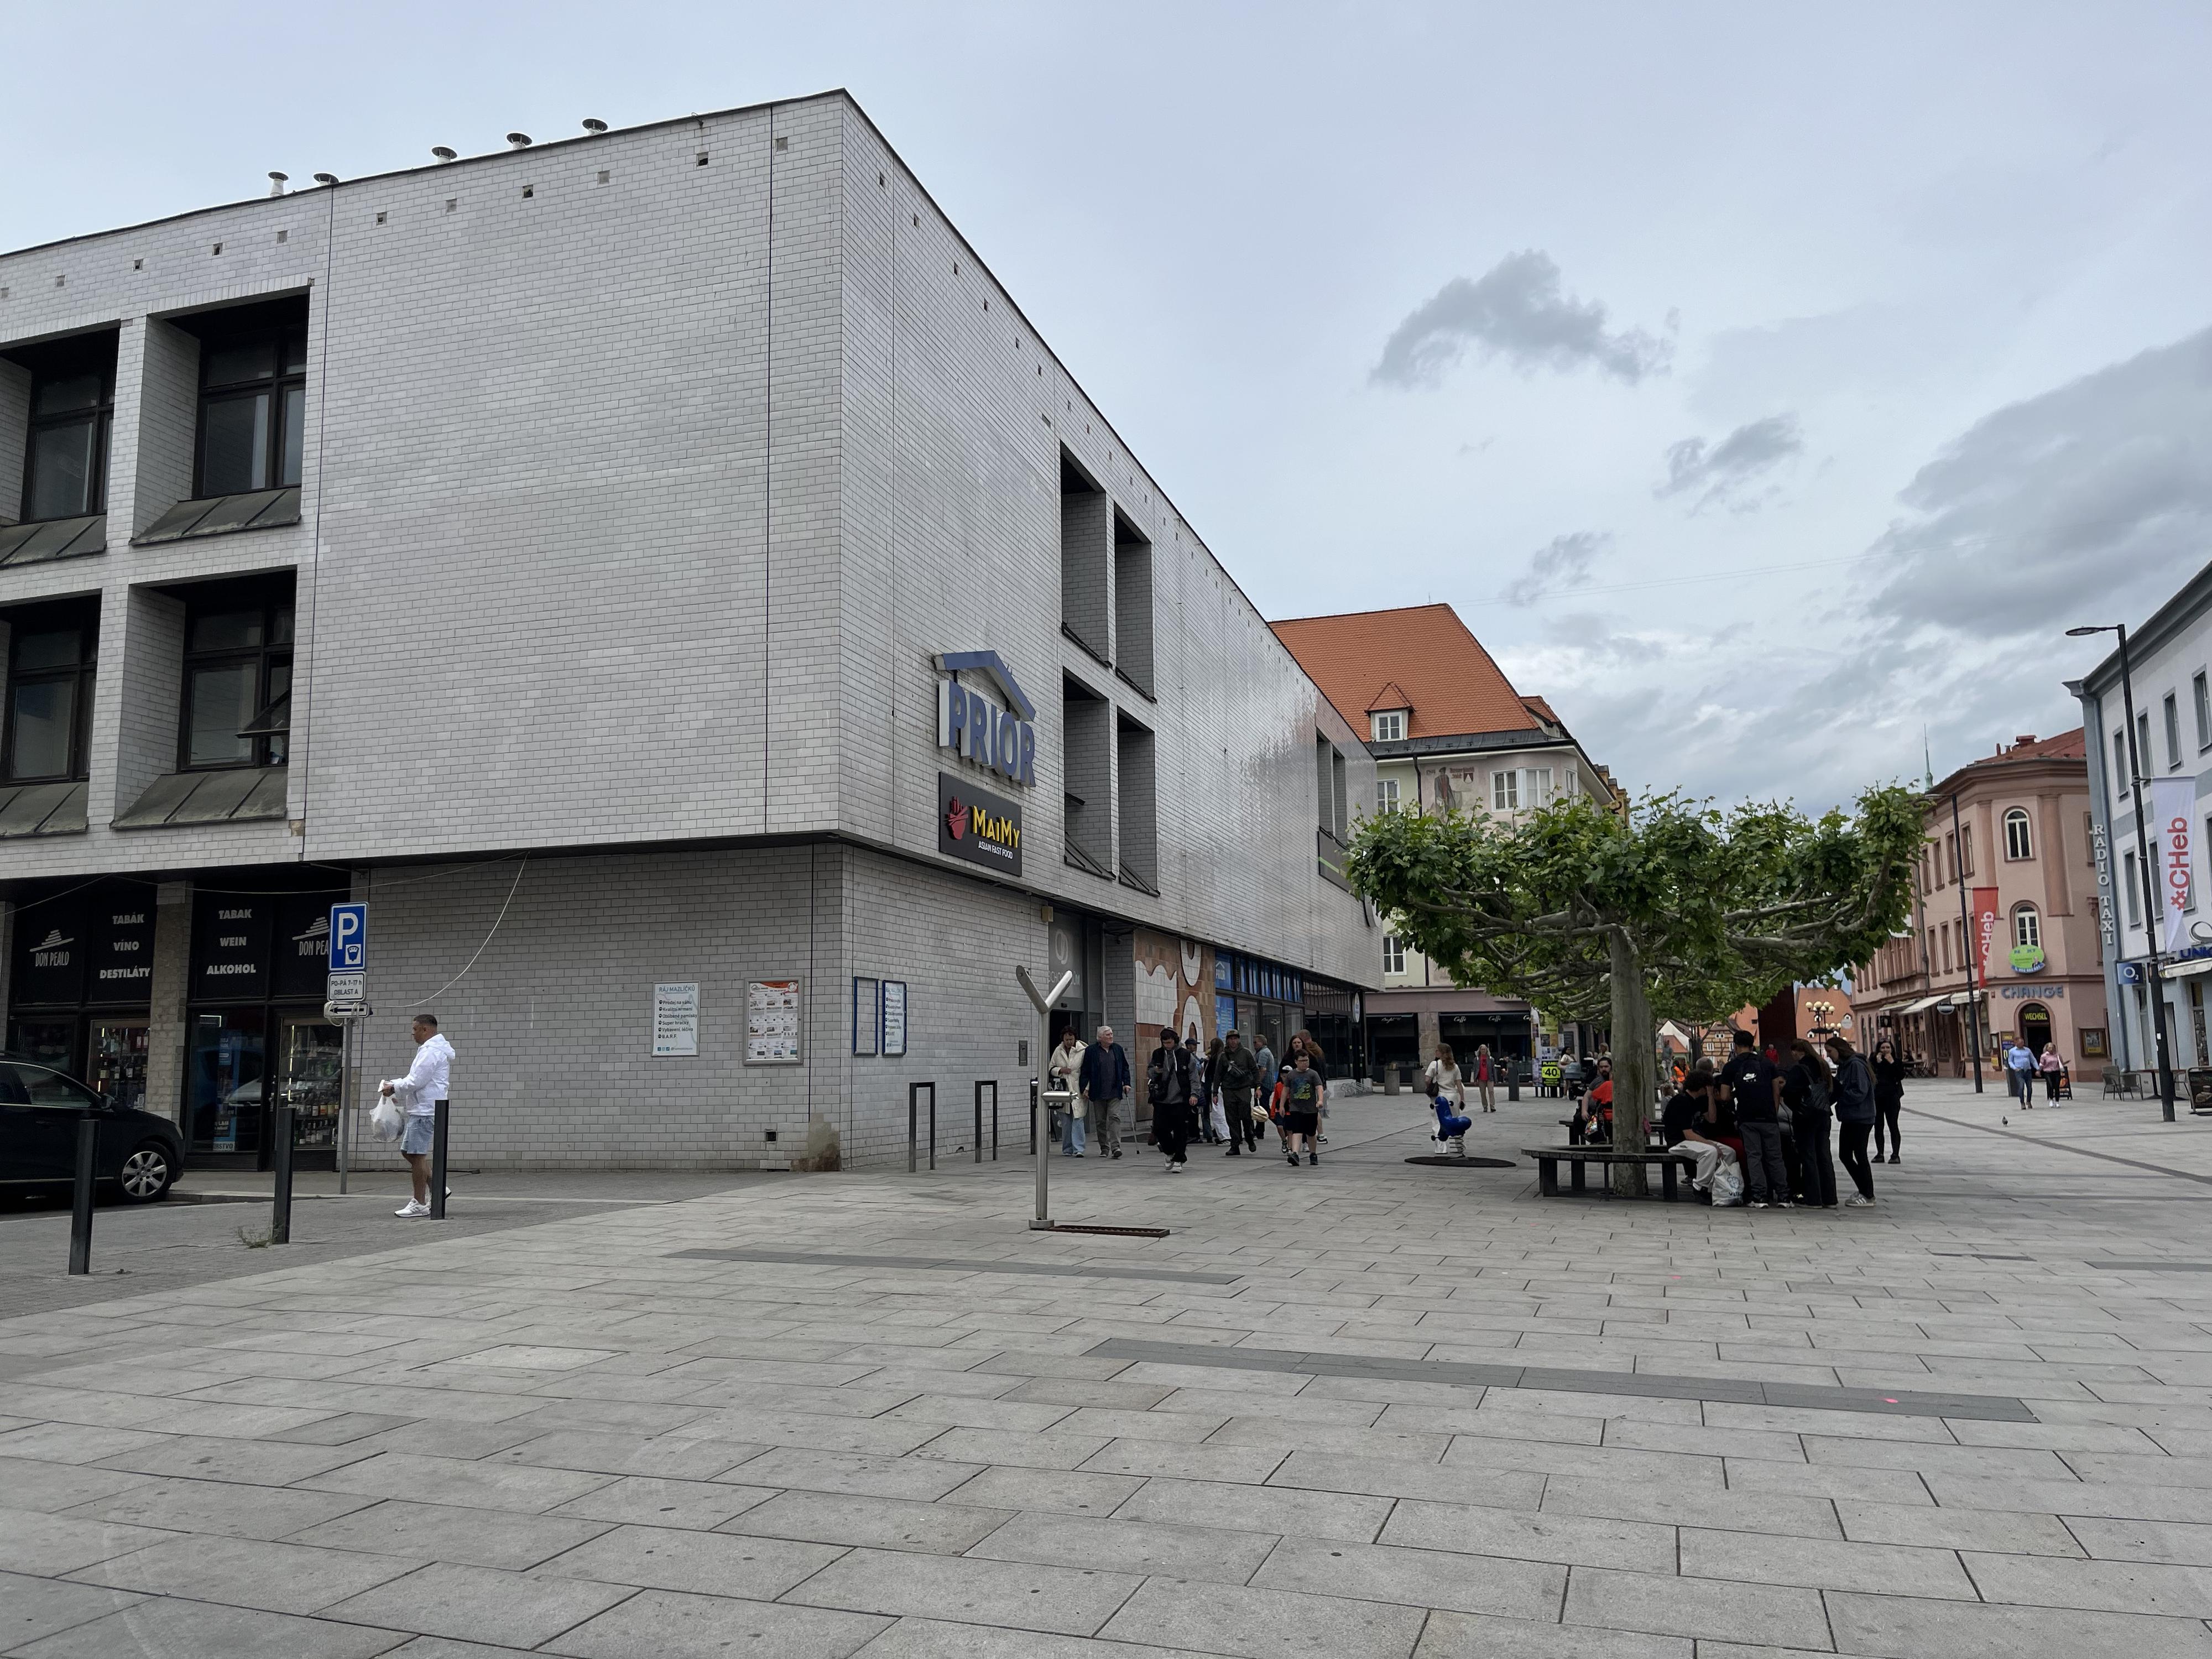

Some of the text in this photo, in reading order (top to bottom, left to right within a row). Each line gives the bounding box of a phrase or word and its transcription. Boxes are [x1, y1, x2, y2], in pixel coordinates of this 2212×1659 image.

[940, 680, 1036, 787] PRIOR
[978, 841, 1013, 859] ASIAN FAST FOOD
[2094, 825, 2114, 946] RADIO TAXI
[112, 912, 145, 925] TABÁK
[218, 909, 252, 920] TABAK
[337, 912, 359, 950] P
[113, 940, 140, 951] VÍNO
[220, 937, 247, 947] WEIN
[299, 940, 328, 956] DON PEA
[35, 952, 49, 967] DON
[100, 966, 150, 979] DESTILÁTY
[206, 963, 257, 975] ALKOHOL
[2001, 985, 2064, 999] CHANGE
[2024, 1013, 2048, 1021] WECHSEL
[1545, 1068, 1557, 1077] 40
